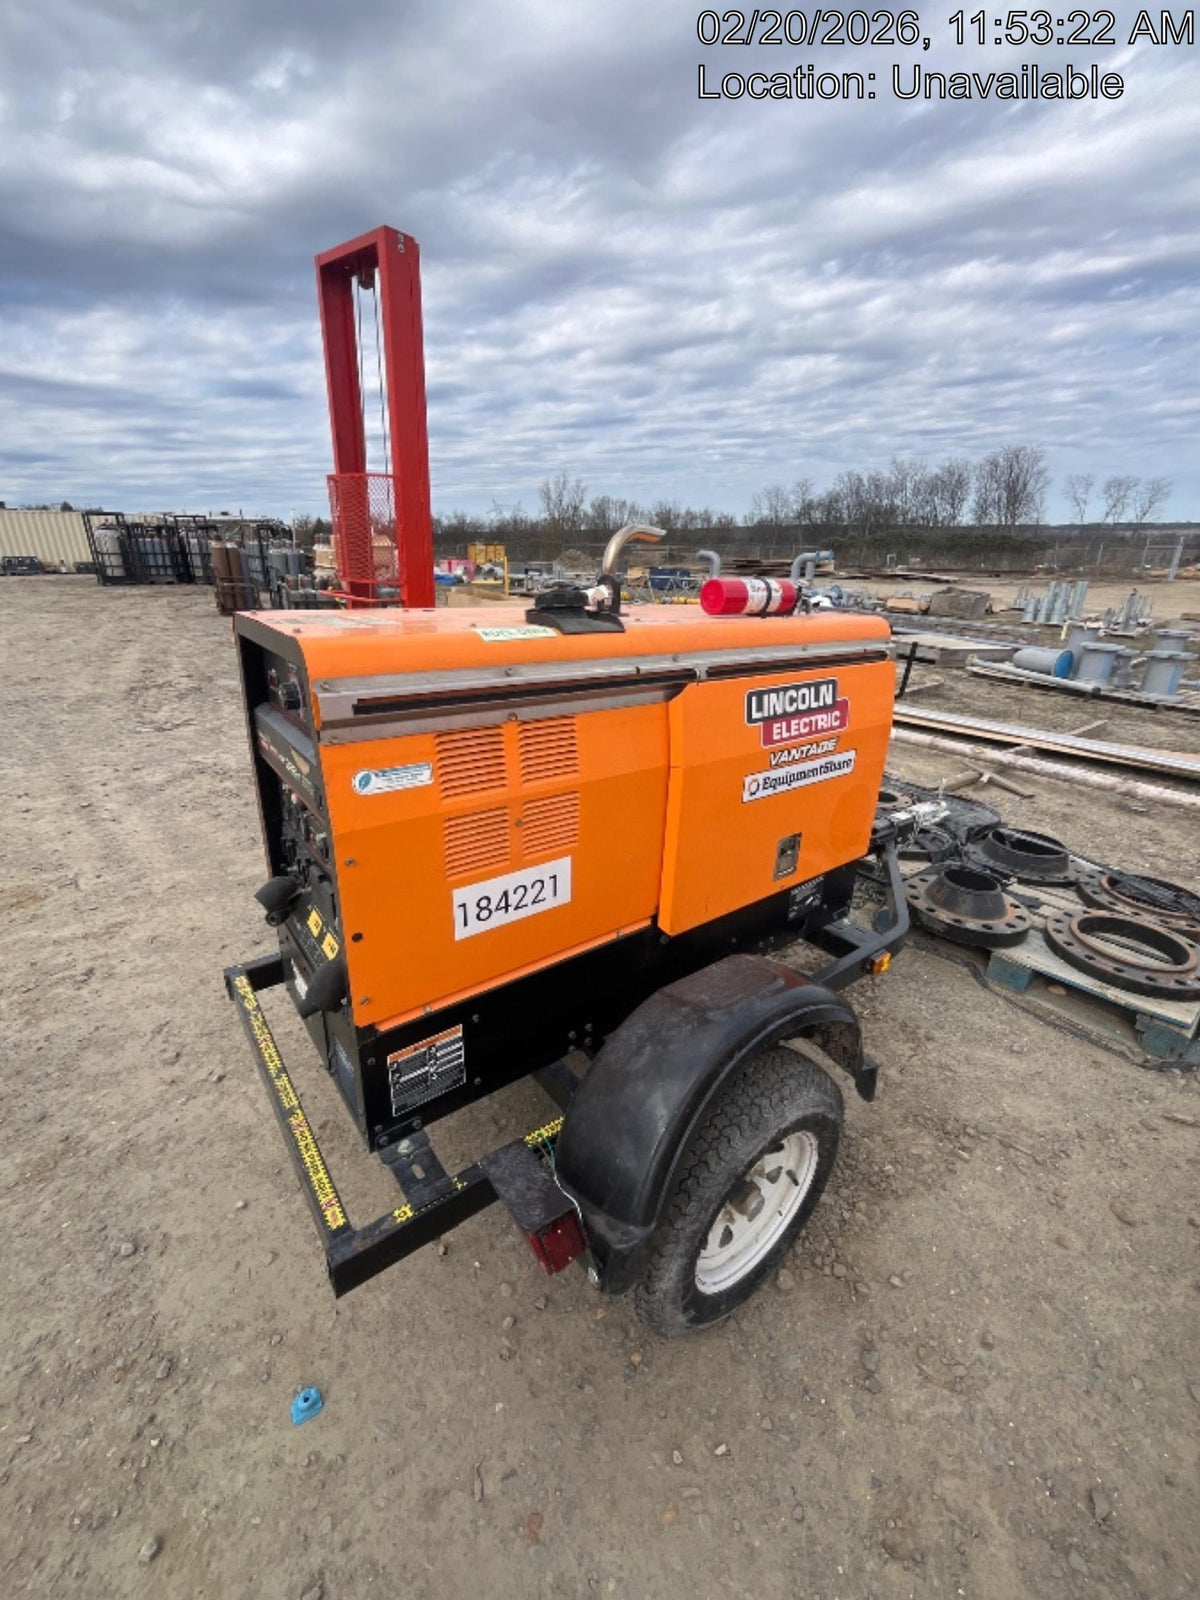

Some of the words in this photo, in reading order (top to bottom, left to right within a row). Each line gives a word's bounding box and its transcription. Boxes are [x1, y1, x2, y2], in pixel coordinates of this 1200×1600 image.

[751, 683, 833, 719] LINCOLN
[772, 710, 840, 741] ELECTRIC
[769, 737, 839, 768] VANTAGE
[458, 874, 558, 928] 184221
